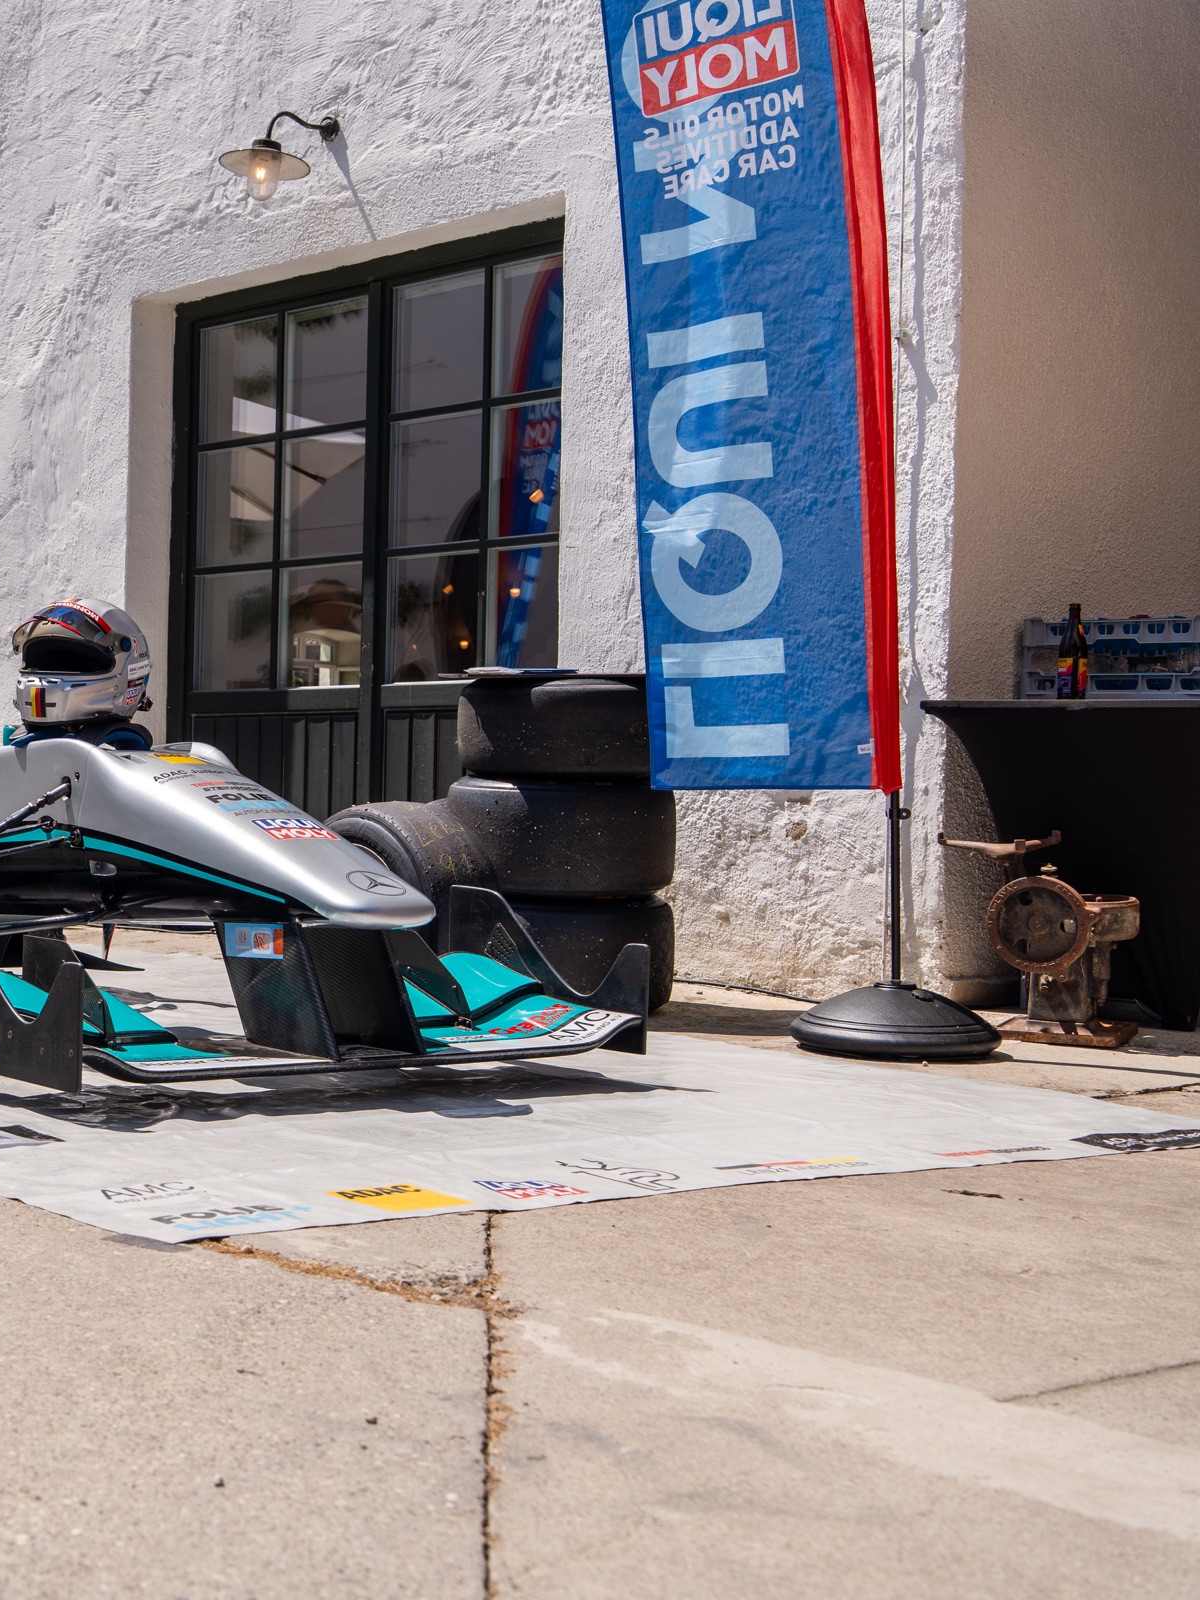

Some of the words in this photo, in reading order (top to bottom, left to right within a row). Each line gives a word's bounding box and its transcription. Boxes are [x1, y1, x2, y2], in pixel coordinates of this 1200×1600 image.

[153, 769, 187, 781] ADAC
[205, 792, 277, 803] FOLIE
[255, 819, 325, 829] LIQUI
[269, 829, 336, 839] MOLY
[549, 1012, 611, 1040] AMC
[100, 1181, 195, 1200] AMC
[336, 1184, 423, 1201] ADAC
[149, 1204, 285, 1225] FOLIE
